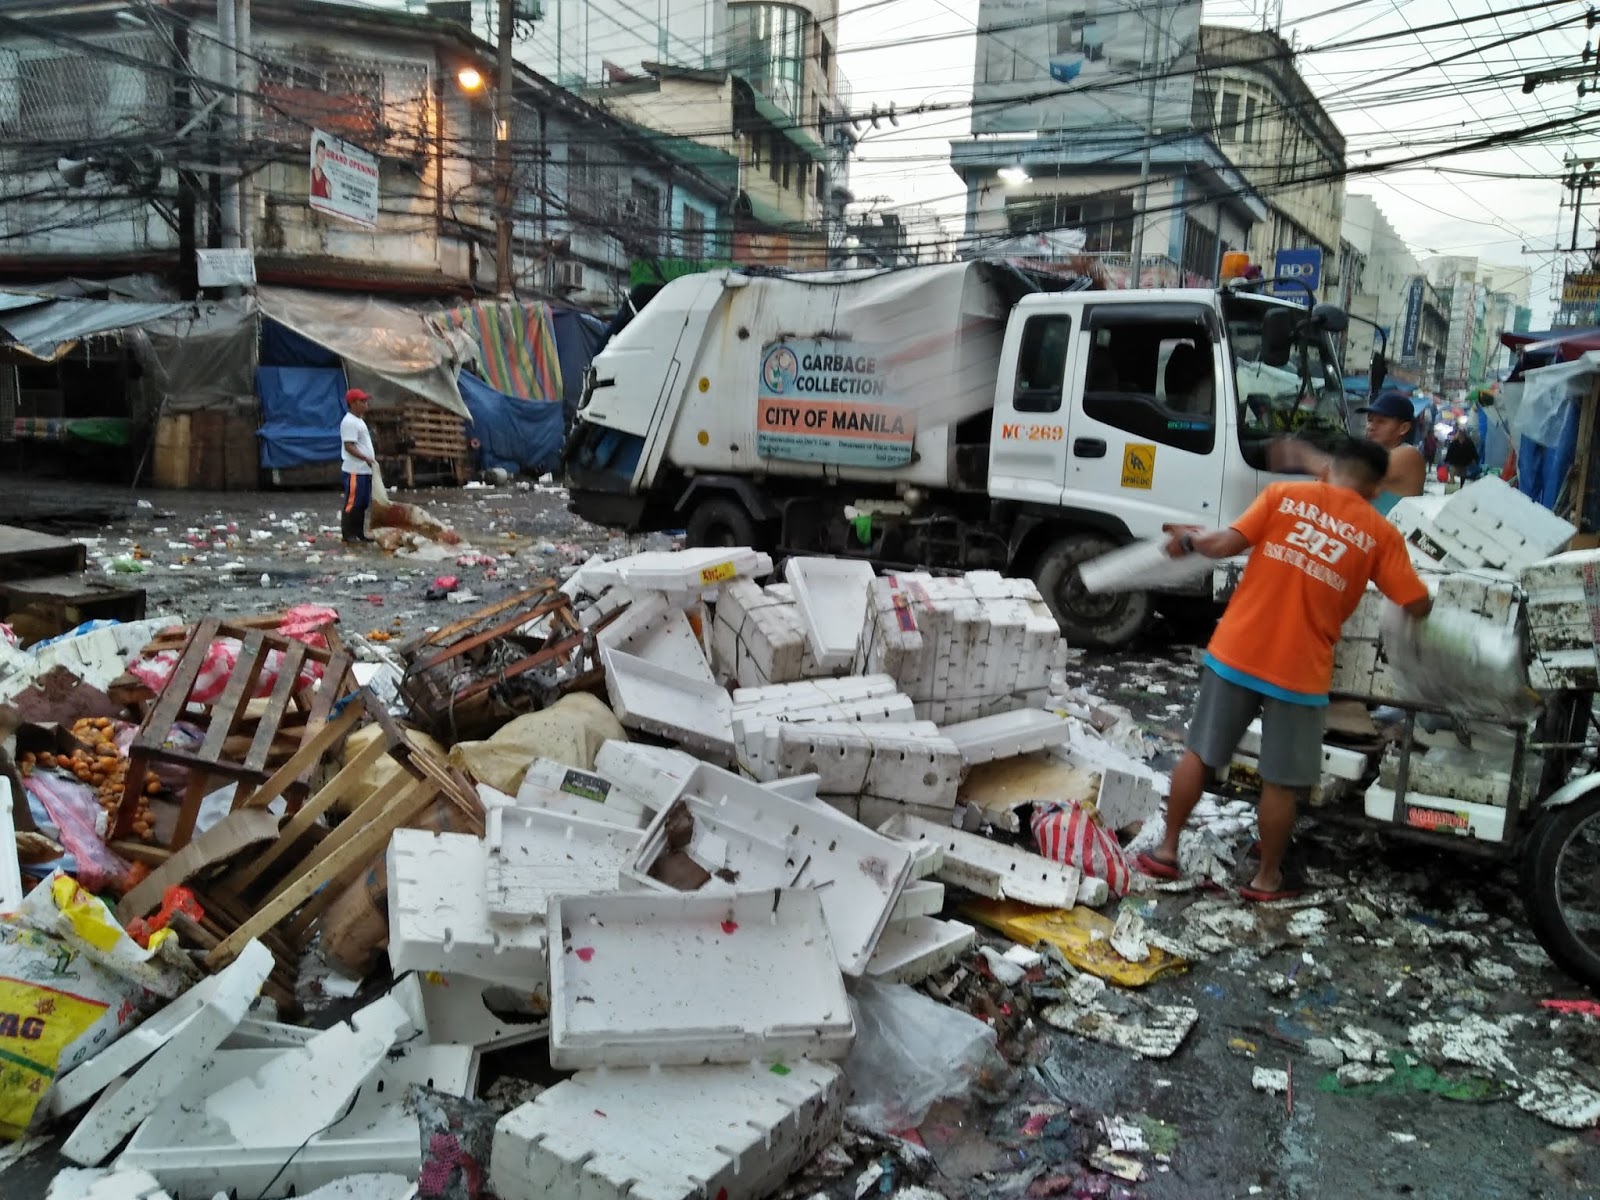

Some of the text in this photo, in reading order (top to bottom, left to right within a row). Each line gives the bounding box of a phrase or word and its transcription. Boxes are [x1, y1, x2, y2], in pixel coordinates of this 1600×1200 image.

[1280, 263, 1314, 278] BDO
[802, 353, 877, 375] GARBAGE
[796, 375, 884, 397] COLLECTION
[765, 406, 905, 435] CITY OF MANILA
[1278, 496, 1377, 554] BARANGAY
[1284, 520, 1348, 565] 293
[0, 1012, 46, 1040] AG
